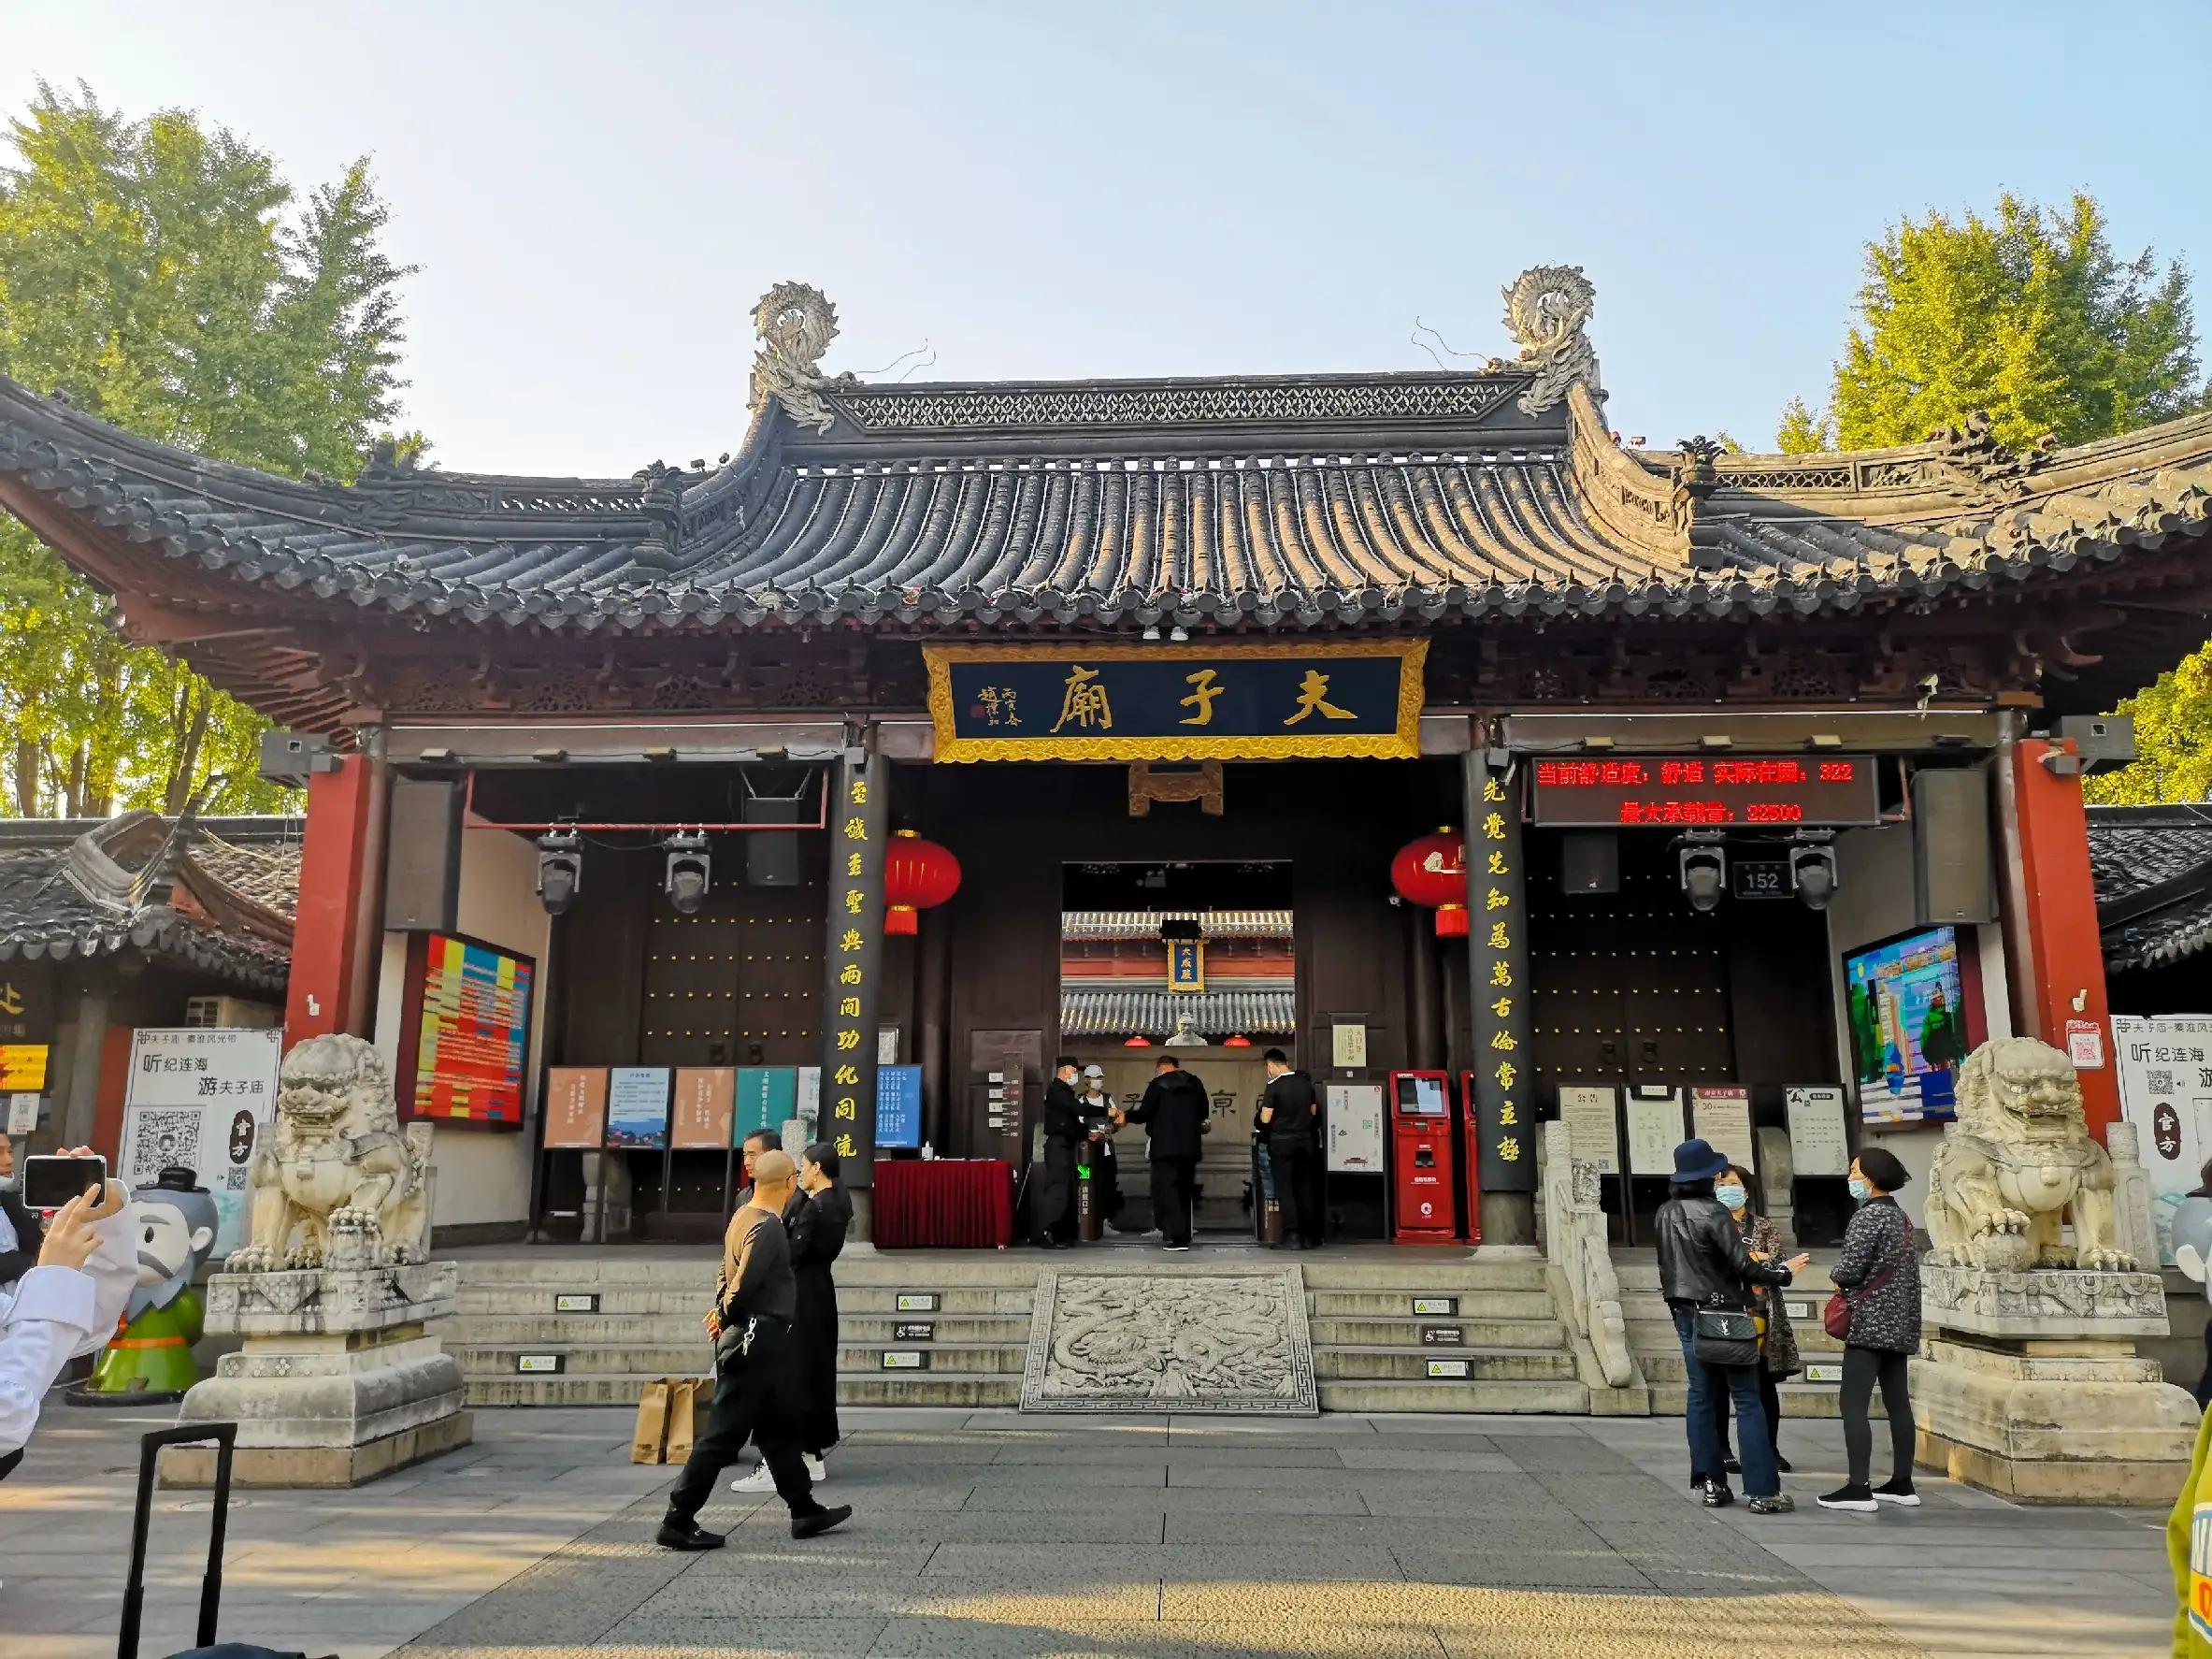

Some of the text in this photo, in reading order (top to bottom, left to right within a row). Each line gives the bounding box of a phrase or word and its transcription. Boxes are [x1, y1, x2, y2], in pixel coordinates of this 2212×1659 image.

[1746, 873, 1779, 888] 152
[2132, 1043, 2205, 1062] 听纪连海
[143, 1054, 208, 1073] 听纪连海
[198, 1077, 265, 1096] 游夫子庙
[2158, 1113, 2176, 1153] 官方
